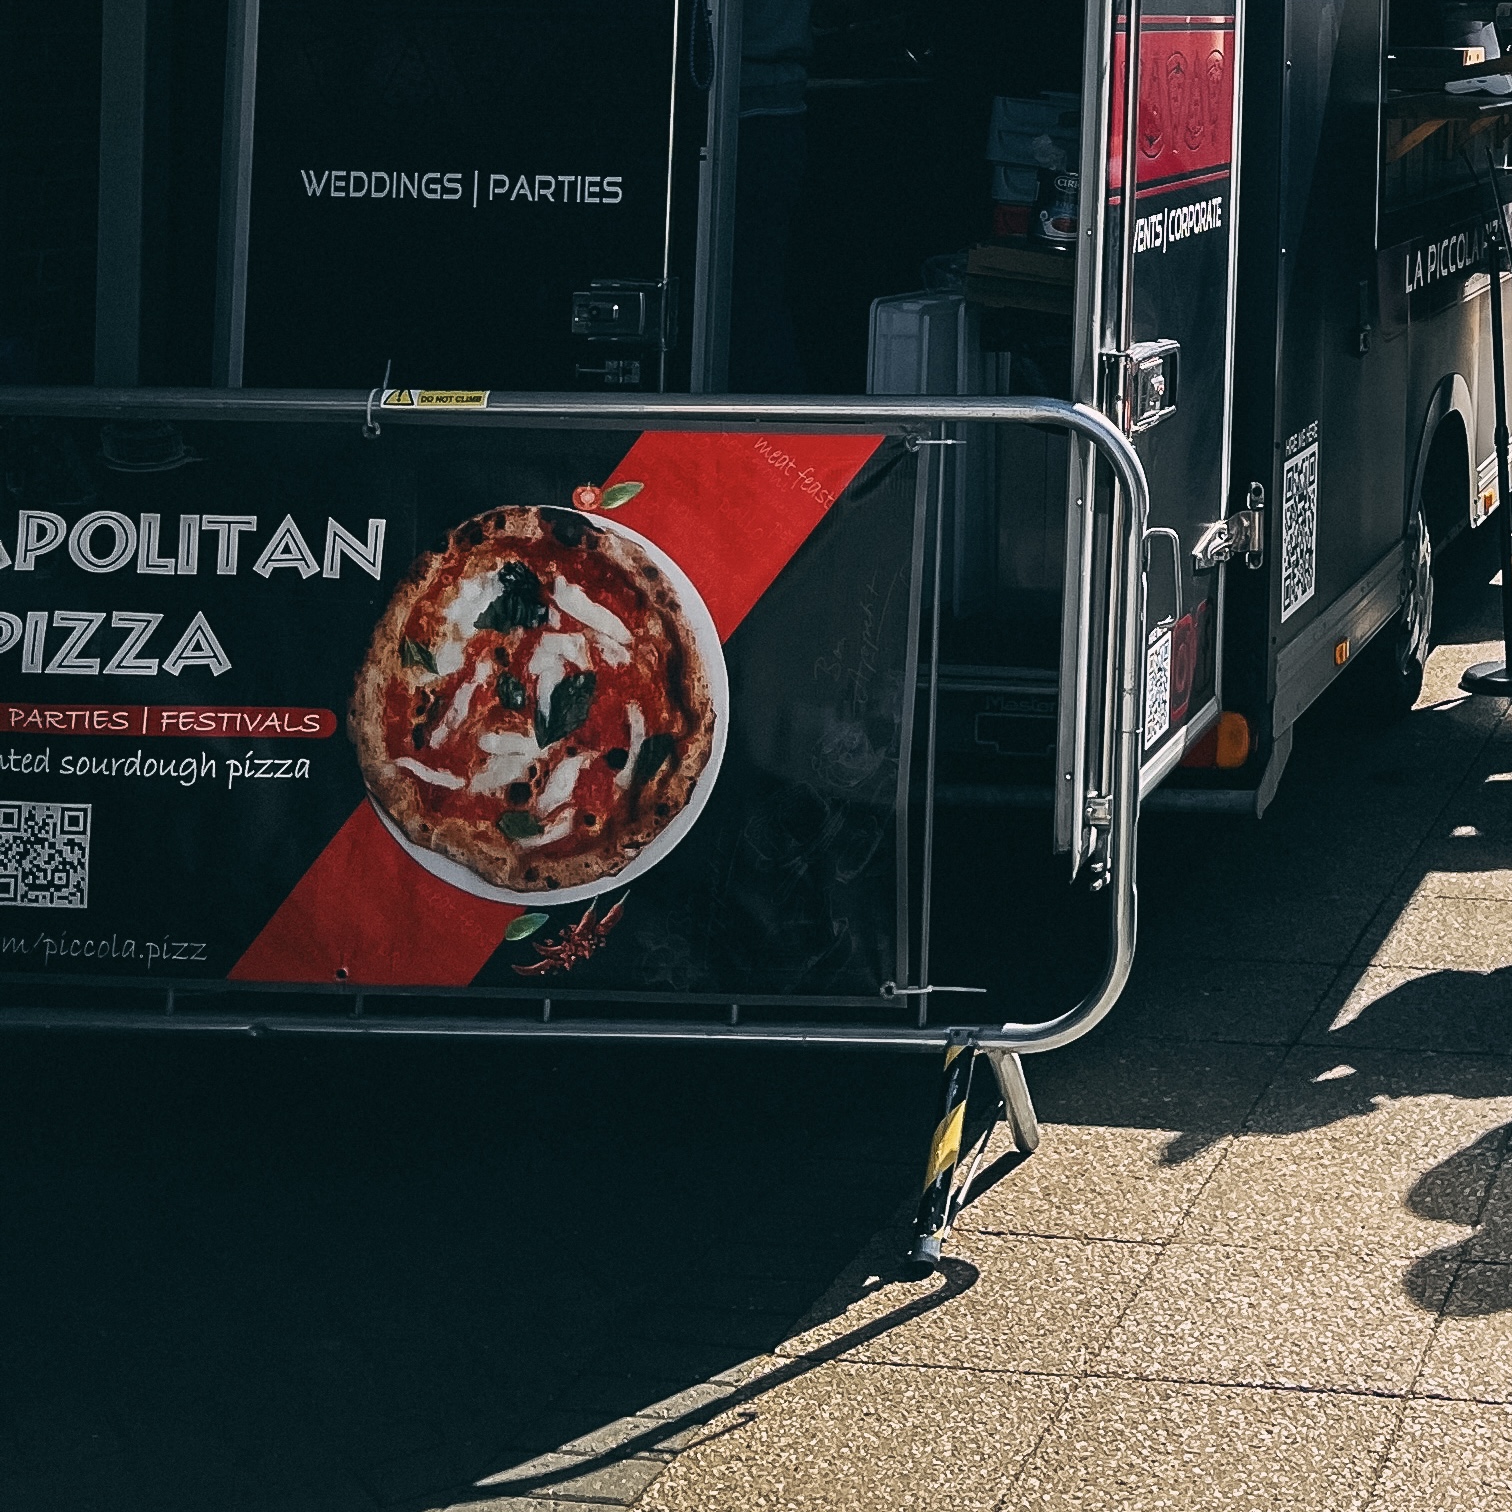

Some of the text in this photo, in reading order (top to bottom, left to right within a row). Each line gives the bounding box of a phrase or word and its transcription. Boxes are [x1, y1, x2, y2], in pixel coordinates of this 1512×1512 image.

[300, 169, 624, 205] WEDDINGS PARTIES
[1168, 196, 1223, 243] CORPORATE
[1405, 250, 1424, 294] LA
[1427, 227, 1480, 284] PICCOLA
[420, 395, 434, 404] DO
[435, 395, 454, 404] NOT
[753, 436, 798, 476] meat
[791, 466, 837, 510] feast
[0, 509, 386, 581] POLITAN
[8, 707, 321, 733] PARTIES FESTIVALS
[59, 749, 217, 787] sourdough
[226, 749, 310, 790] pizza
